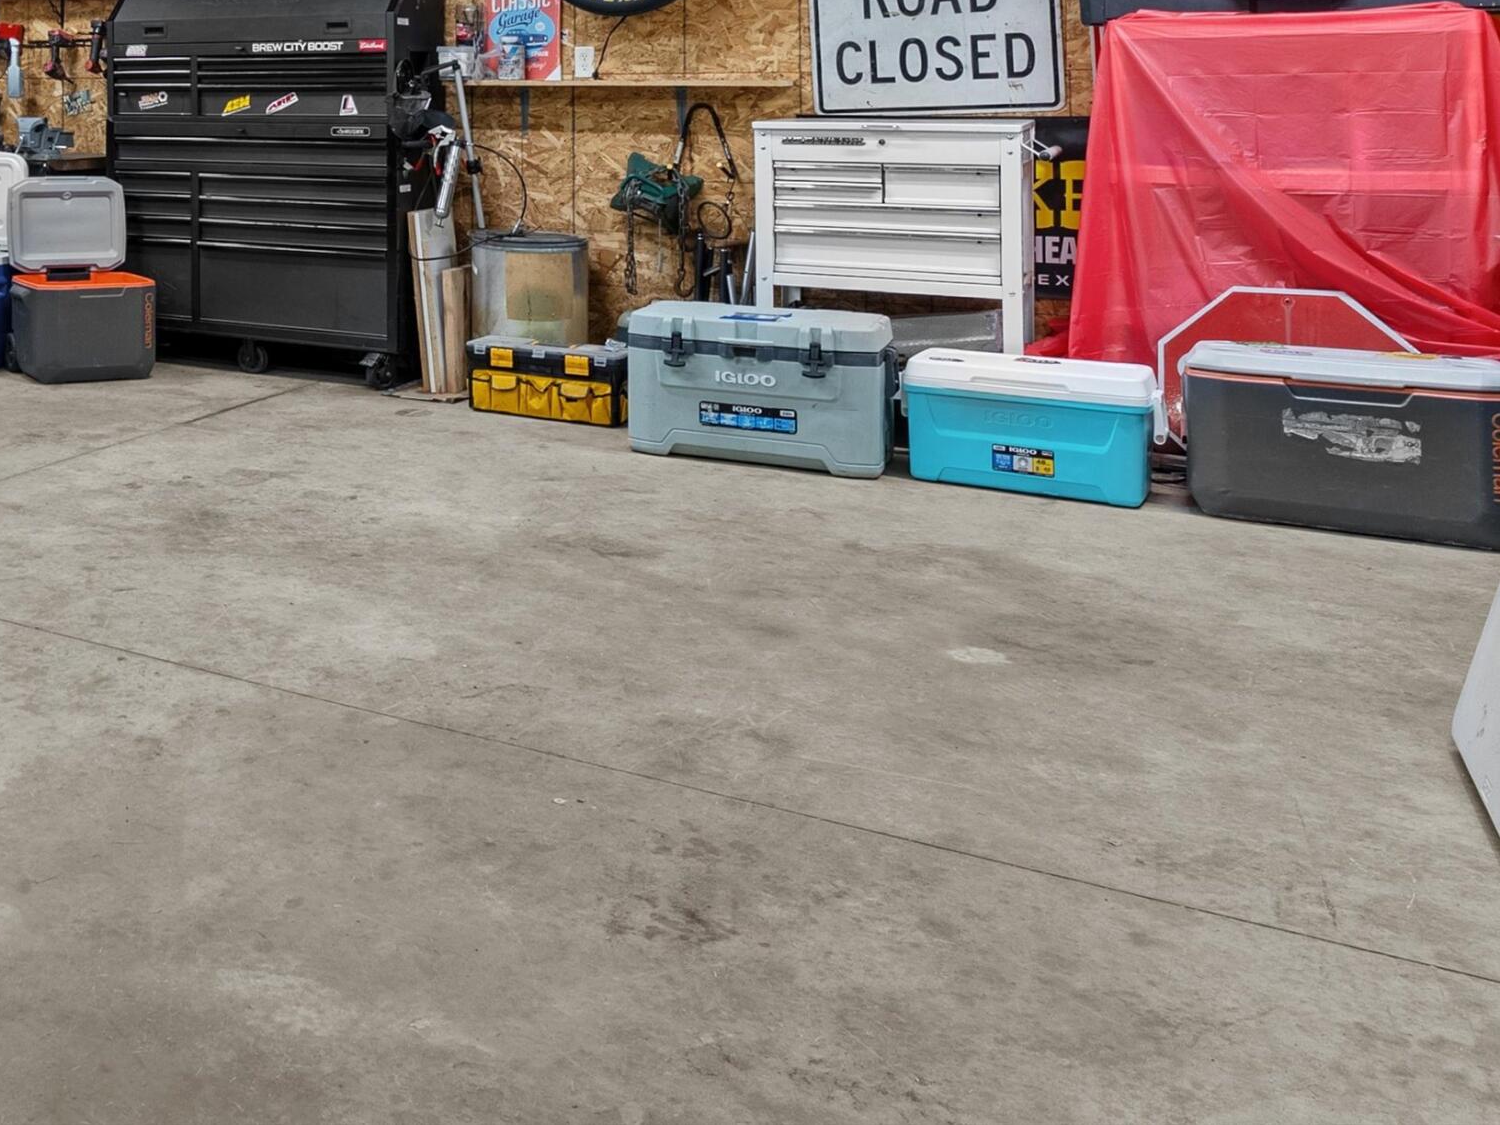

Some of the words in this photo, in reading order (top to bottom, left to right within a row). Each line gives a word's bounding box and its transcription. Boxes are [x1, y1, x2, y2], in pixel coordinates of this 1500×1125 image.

[496, 9, 540, 35] Garage
[252, 43, 283, 52] BREW
[283, 40, 306, 51] CITY
[307, 41, 344, 51] BOOST
[836, 32, 1036, 85] CLOSED
[145, 292, 154, 349] Coleman
[715, 370, 776, 387] IGLOO
[732, 405, 762, 414] IGLOO
[1009, 447, 1037, 455] IGLOO
